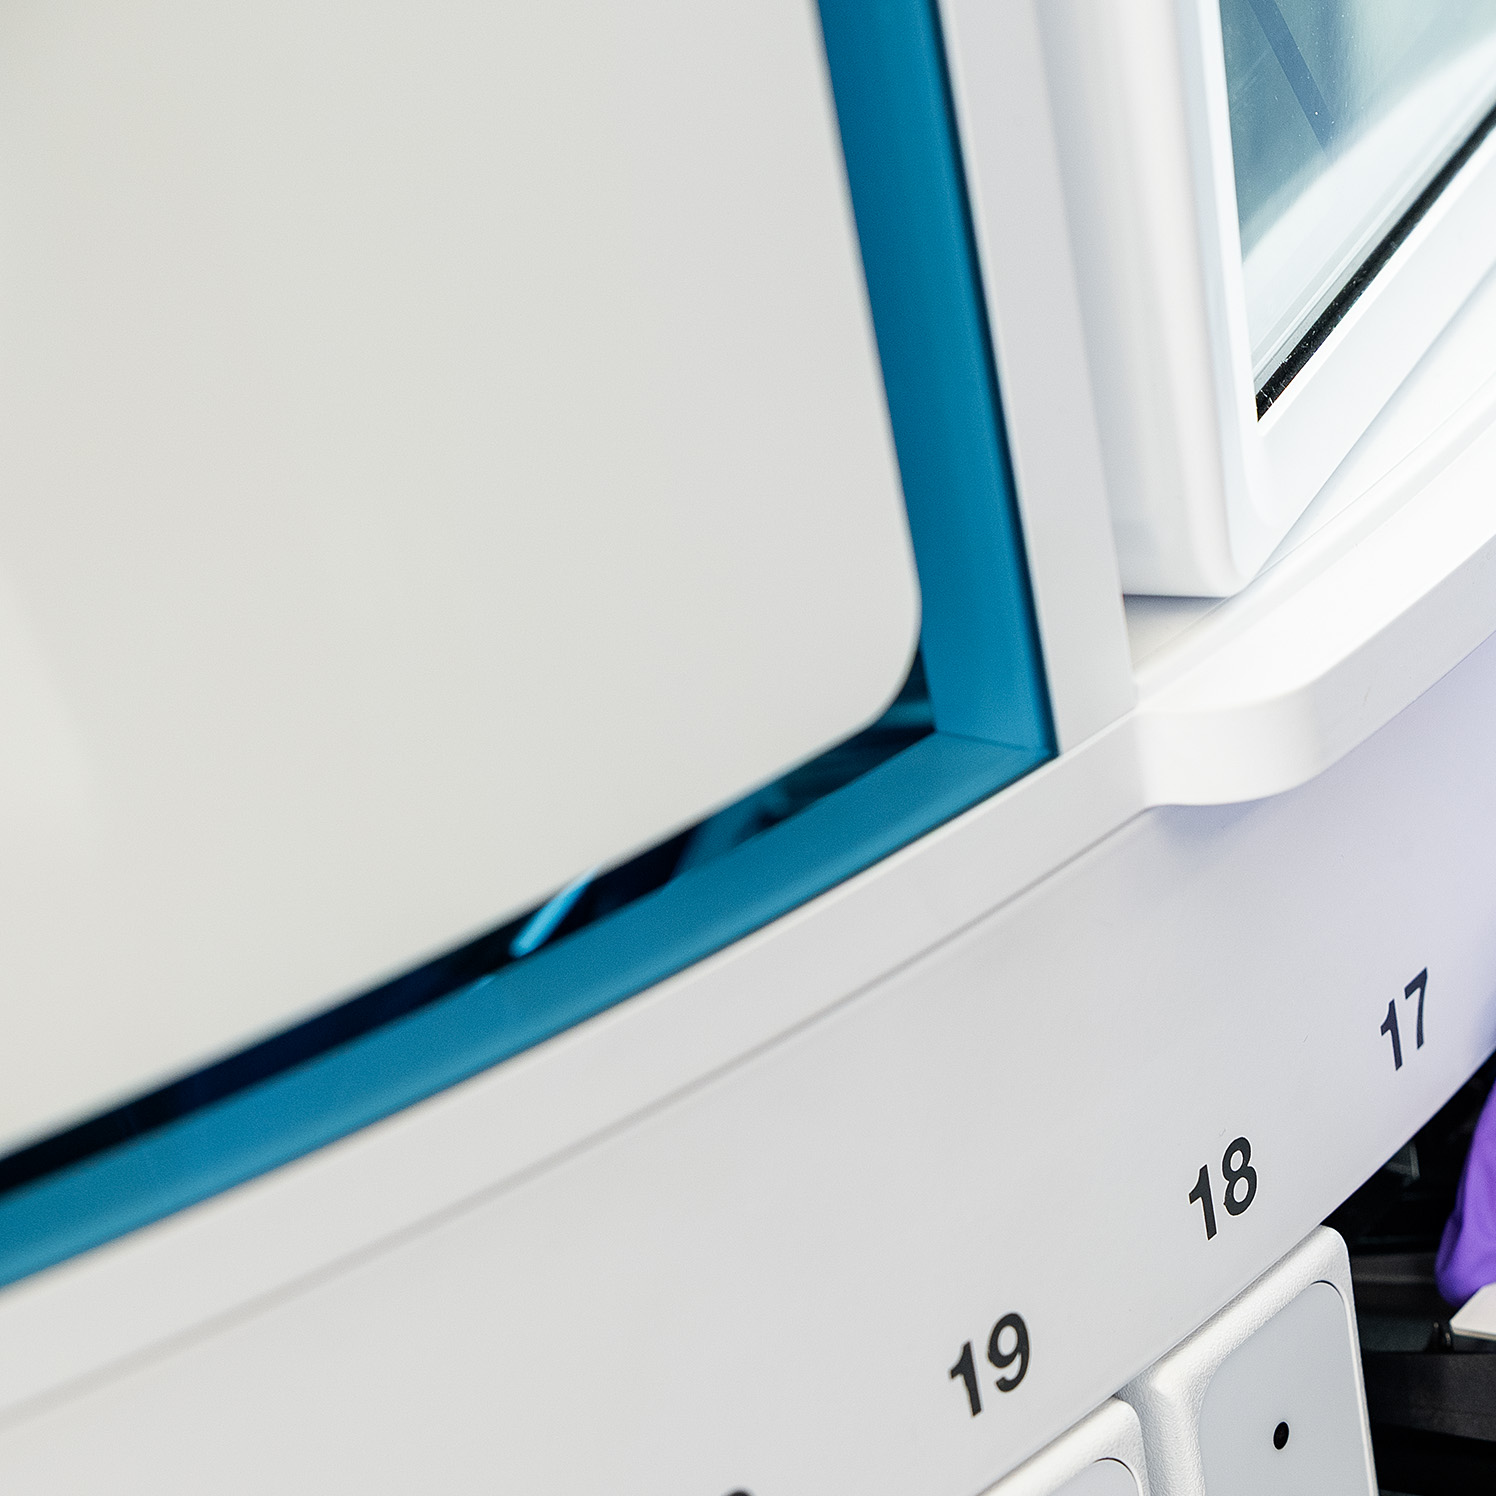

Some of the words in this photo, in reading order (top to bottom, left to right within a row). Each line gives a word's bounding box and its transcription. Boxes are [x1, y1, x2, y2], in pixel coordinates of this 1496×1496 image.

[1380, 967, 1428, 1071] 17
[1188, 1136, 1258, 1241] 18
[949, 1312, 1030, 1417] 19
